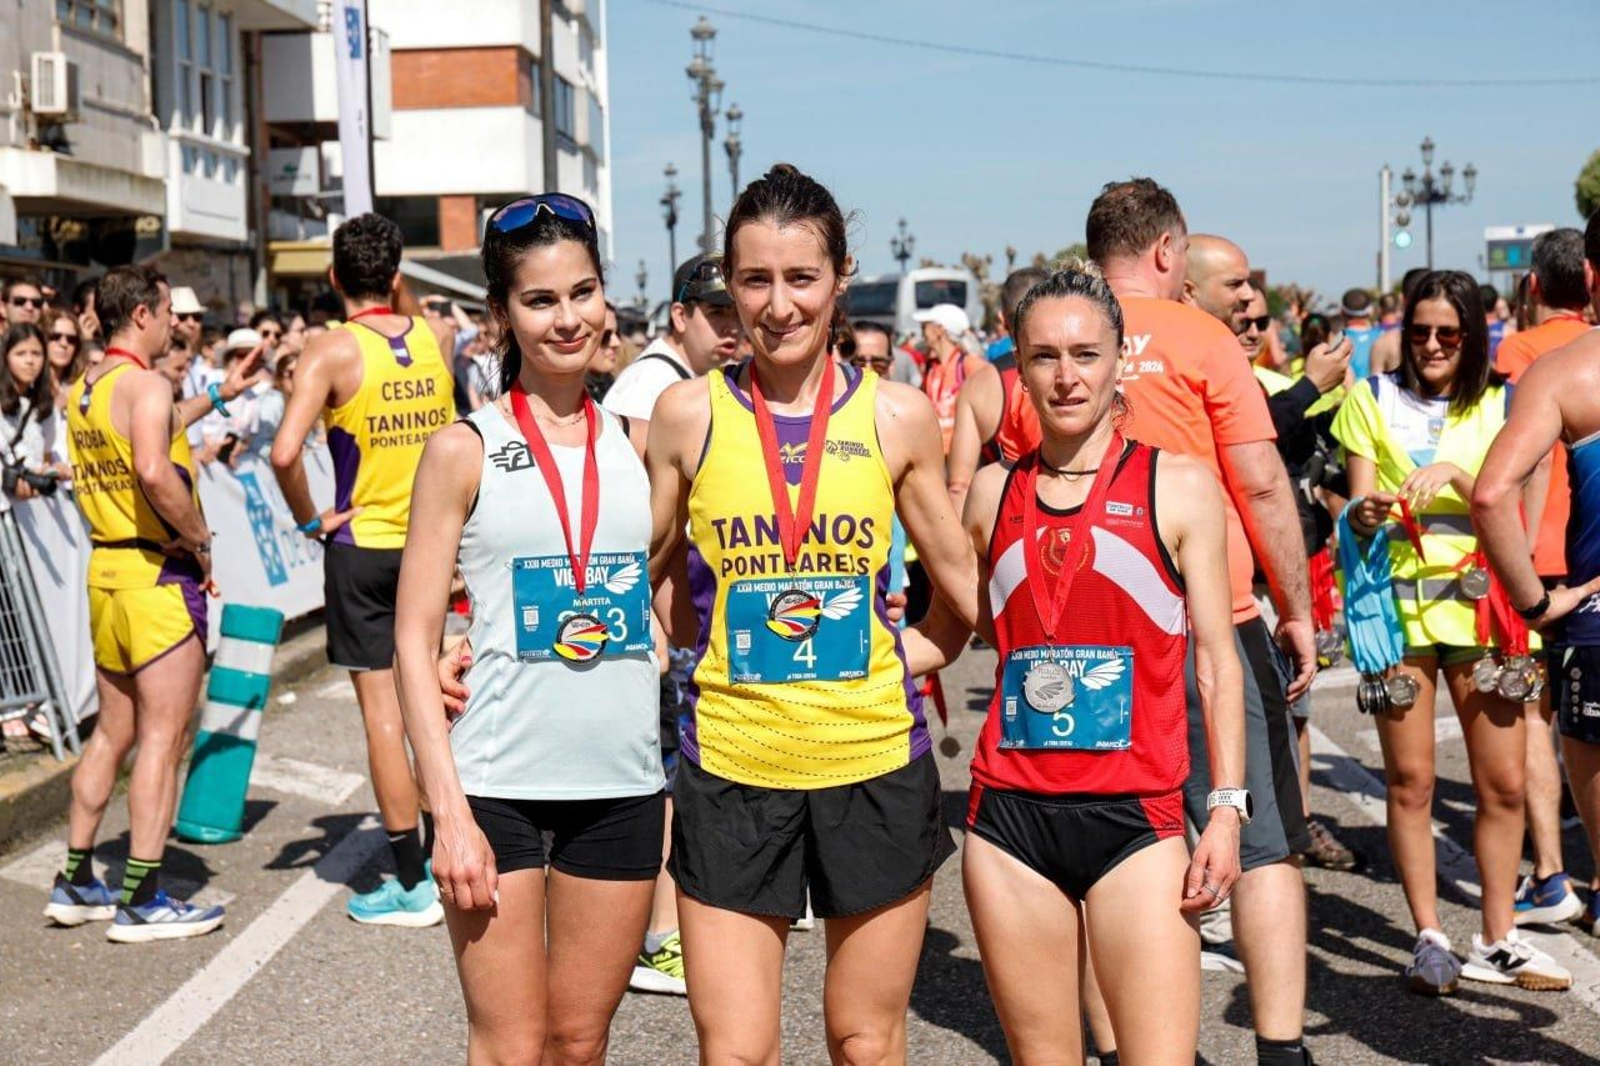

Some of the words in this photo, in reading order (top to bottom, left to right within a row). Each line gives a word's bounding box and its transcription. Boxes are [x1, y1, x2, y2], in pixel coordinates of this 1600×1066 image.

[382, 378, 435, 402] CESAR
[367, 408, 447, 433] TANINOS
[711, 513, 874, 550] TANNOS
[541, 558, 563, 568] MEDIO
[600, 556, 617, 565] GRAN
[814, 580, 834, 590] GRAN
[573, 597, 611, 606] MARTITA
[793, 637, 817, 668] 4
[1075, 650, 1095, 659] GRAN
[1052, 704, 1075, 737] 5
